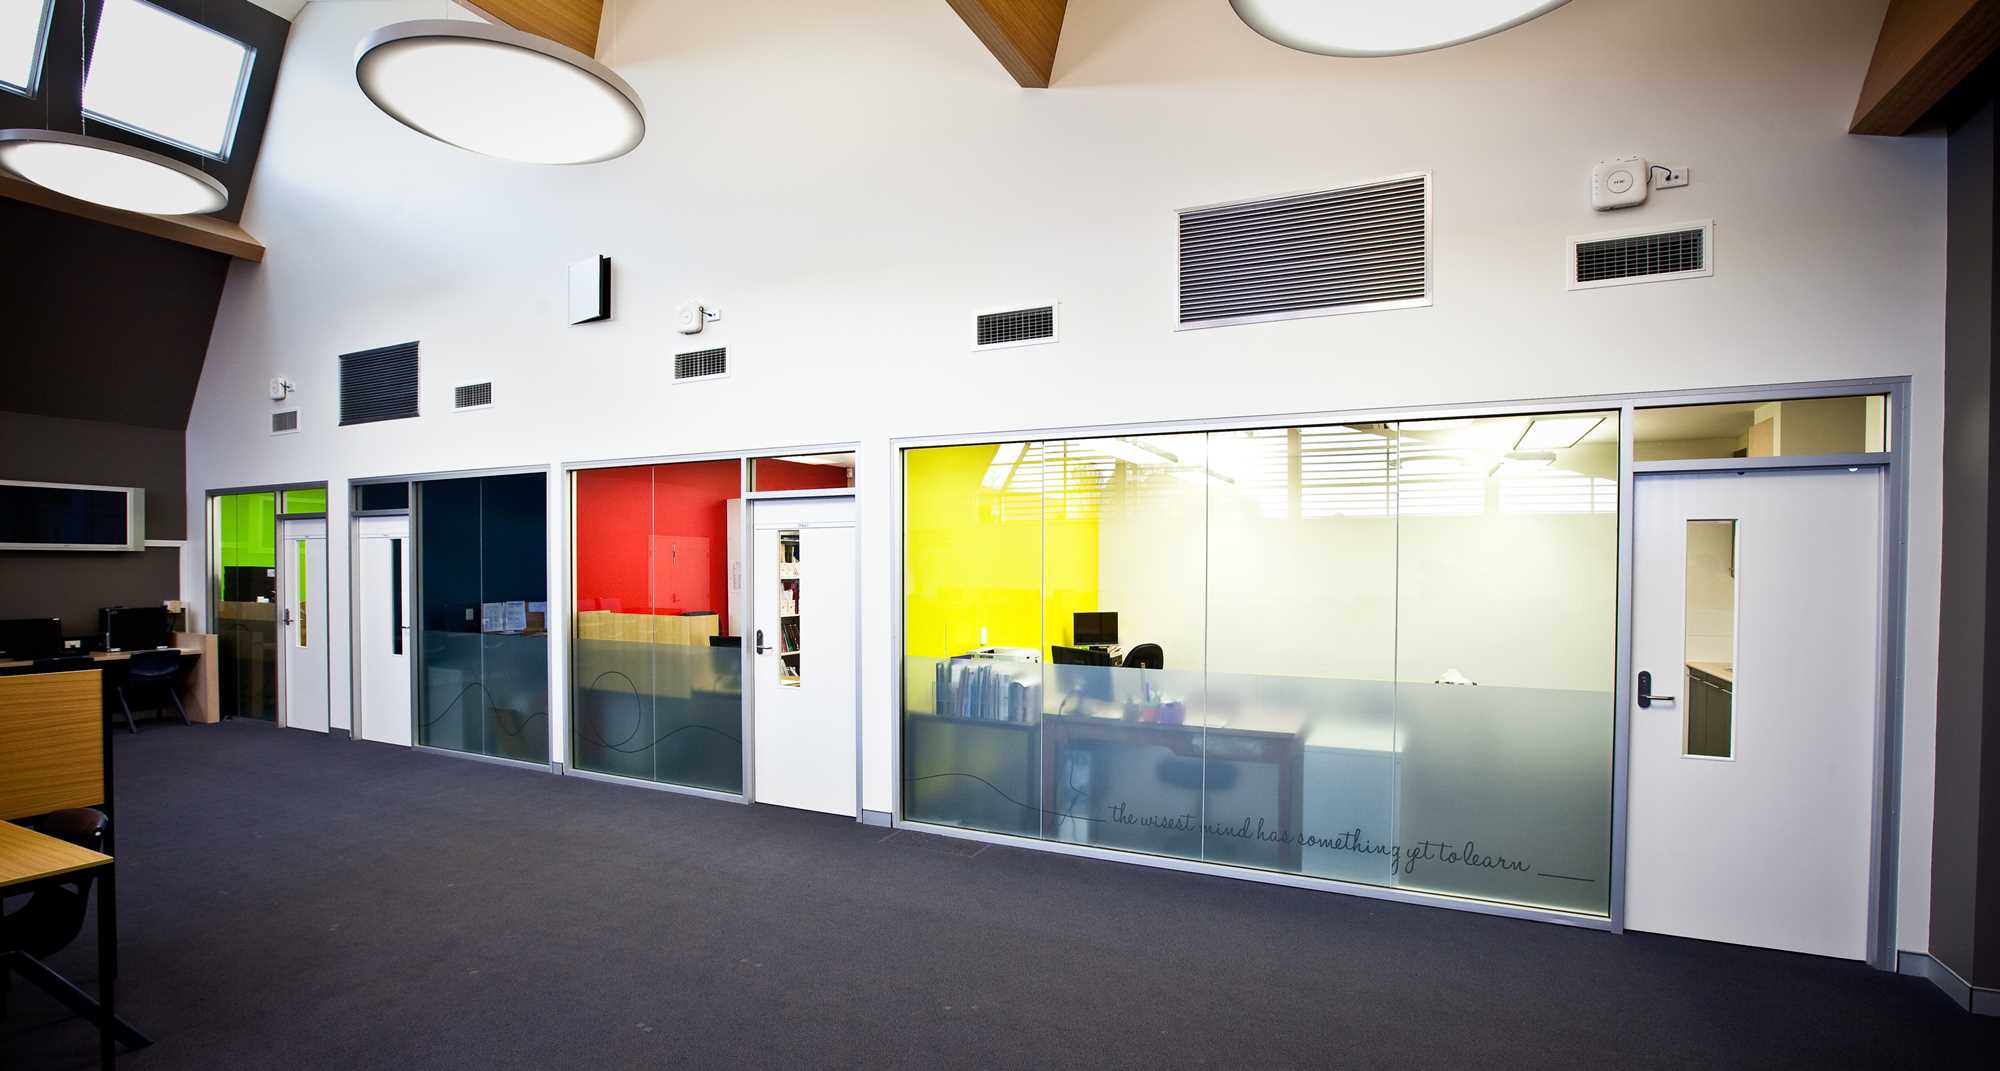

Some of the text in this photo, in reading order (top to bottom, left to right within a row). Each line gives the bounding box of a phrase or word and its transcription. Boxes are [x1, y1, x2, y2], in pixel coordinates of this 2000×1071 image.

[1108, 802, 1138, 825] the
[1140, 813, 1196, 832] wisest
[1200, 816, 1254, 839] mind
[1257, 817, 1292, 844] has
[1297, 827, 1400, 876] something
[1405, 840, 1436, 874] yet
[1463, 840, 1532, 872] learn
